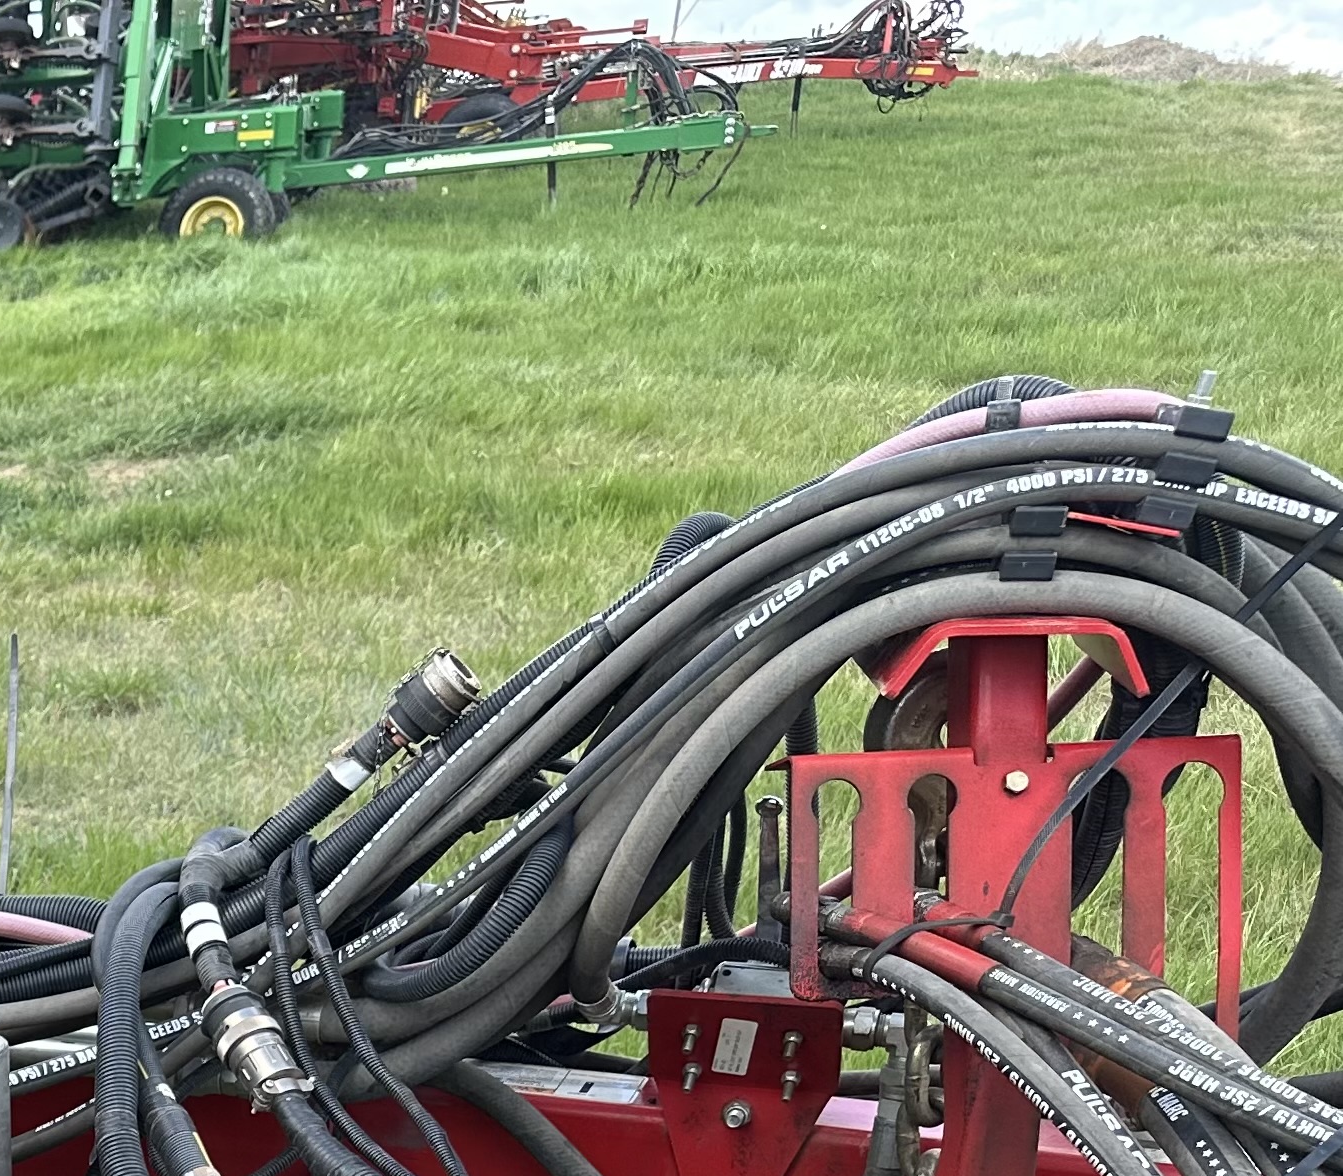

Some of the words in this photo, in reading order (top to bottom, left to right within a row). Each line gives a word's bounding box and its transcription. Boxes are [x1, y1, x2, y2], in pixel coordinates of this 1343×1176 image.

[734, 551, 849, 639] PULSAR
[854, 503, 945, 554] 112CC-08
[1006, 473, 1056, 493] 4000
[1061, 468, 1093, 484] PSI
[1114, 468, 1148, 483] 275
[1235, 487, 1311, 520] EXCEEDS
[18, 1066, 40, 1083] PSI
[52, 1055, 75, 1073] 275
[79, 1046, 97, 1064] BA
[149, 1018, 190, 1040] CEEDS
[1168, 1058, 1221, 1095] HARC
[1219, 1084, 1262, 1113] 2SC
